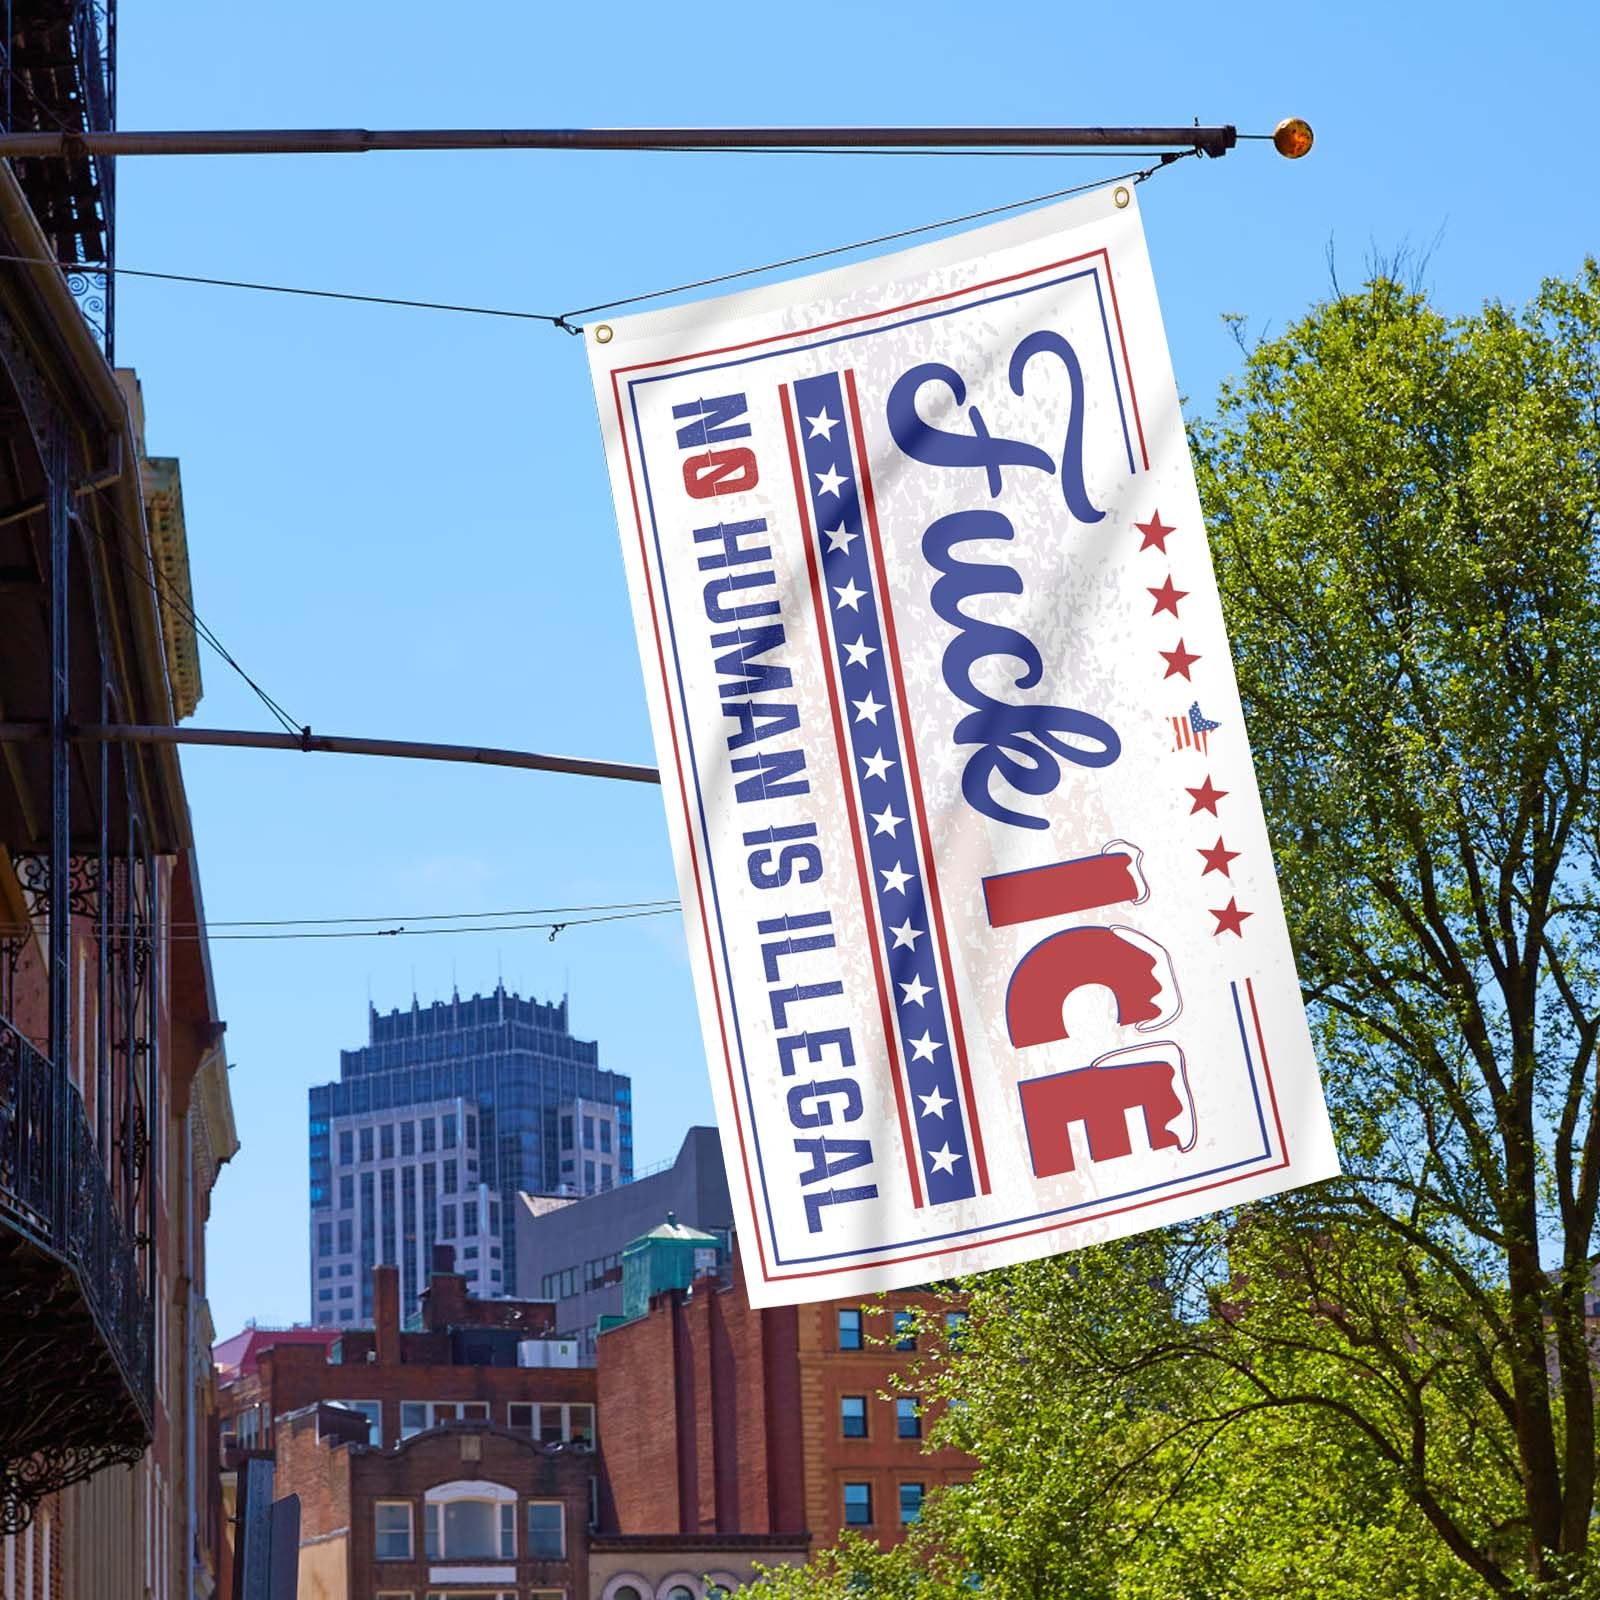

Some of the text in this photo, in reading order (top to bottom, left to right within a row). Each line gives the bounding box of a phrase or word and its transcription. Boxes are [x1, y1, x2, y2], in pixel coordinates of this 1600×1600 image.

[671, 393, 878, 1233] NO HUMAN IS ILLEGAL
[887, 330, 1197, 1178] Fuck ICE
